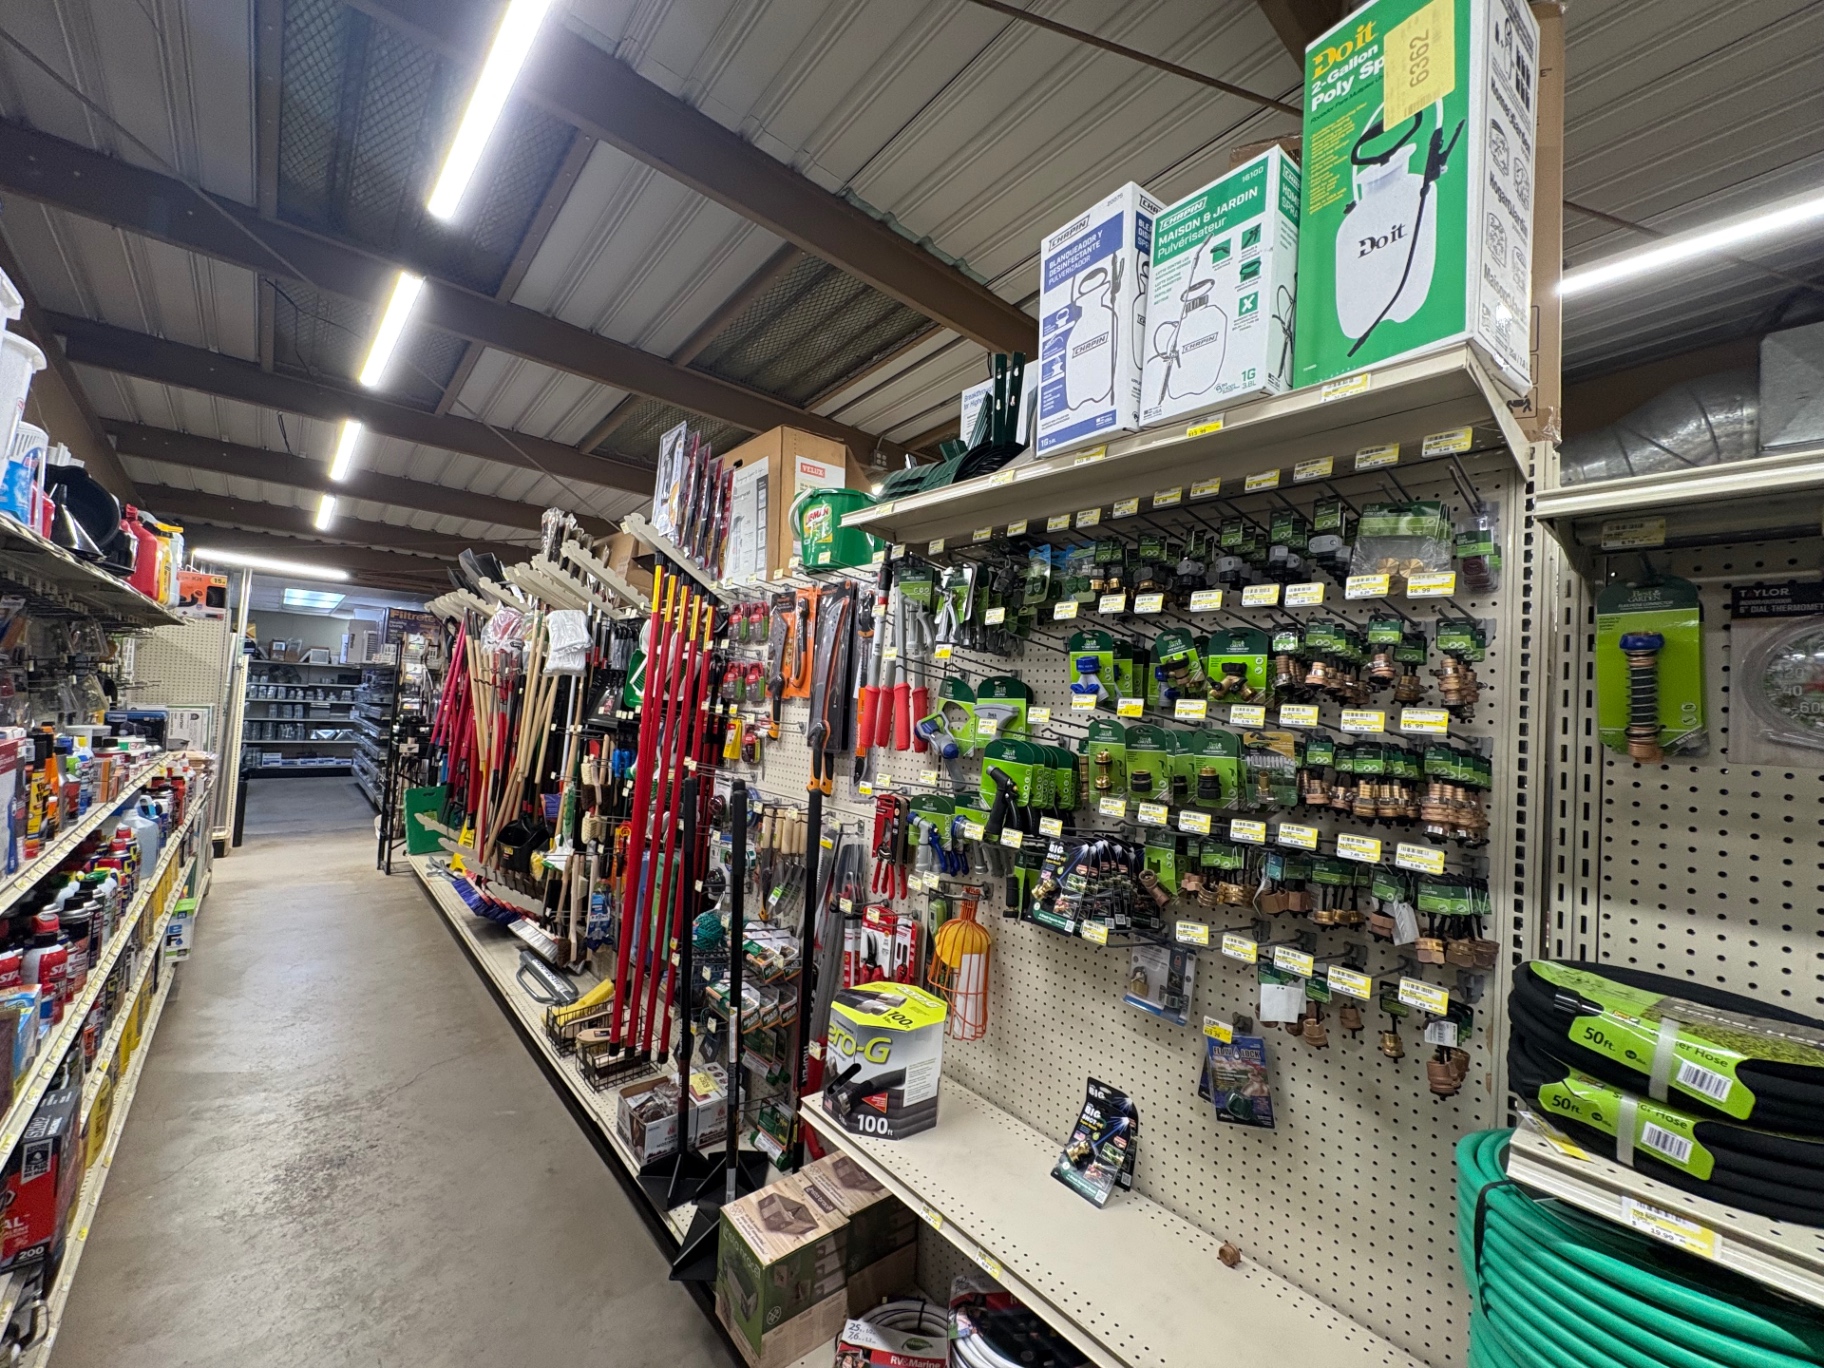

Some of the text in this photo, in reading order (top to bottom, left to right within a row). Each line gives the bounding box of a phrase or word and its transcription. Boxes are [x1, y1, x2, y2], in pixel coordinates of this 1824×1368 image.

[1312, 21, 1379, 80] Do it
[1409, 29, 1429, 88] 6362
[1311, 45, 1379, 95] 2-Gallon
[1312, 56, 1385, 112] Poly Sp
[1242, 166, 1264, 183] 16100
[1158, 217, 1201, 247] MAISON
[1203, 213, 1211, 223] &
[1213, 186, 1258, 219] JARDIN
[1163, 200, 1205, 229] CHAPIN
[1051, 217, 1088, 248] CHAPIN
[1157, 217, 1227, 259] Pulvérisateur
[1357, 222, 1407, 258] Do it
[1049, 230, 1103, 270] BLANQUEADOR Y
[1049, 240, 1101, 278] DESINFECTANTE
[1049, 255, 1091, 286] PULVERIZADOR
[1073, 334, 1107, 357] CHAPIN
[1184, 335, 1216, 351] CHAPIN
[1241, 368, 1256, 382] 1G
[802, 464, 824, 477] VELUX
[1740, 588, 1790, 598] TYLOR
[1751, 605, 1768, 613] DIAL
[1772, 603, 1824, 612] THERMOMET
[1800, 701, 1821, 714] 60
[1049, 844, 1064, 853] BIG
[888, 1011, 913, 1026] 100
[828, 1021, 893, 1064] ero-G
[1583, 1027, 1616, 1052] 50 ft.
[1695, 1047, 1728, 1068] Hose
[1088, 1086, 1105, 1099] BIG
[1085, 1104, 1101, 1118] BIG
[1552, 1094, 1582, 1115] 50 ft.
[857, 1114, 888, 1134] 100
[1655, 1110, 1688, 1129] Hose
[1651, 1228, 1675, 1241] 19.99
[19, 1246, 44, 1260] 200
[848, 1323, 860, 1331] 25
